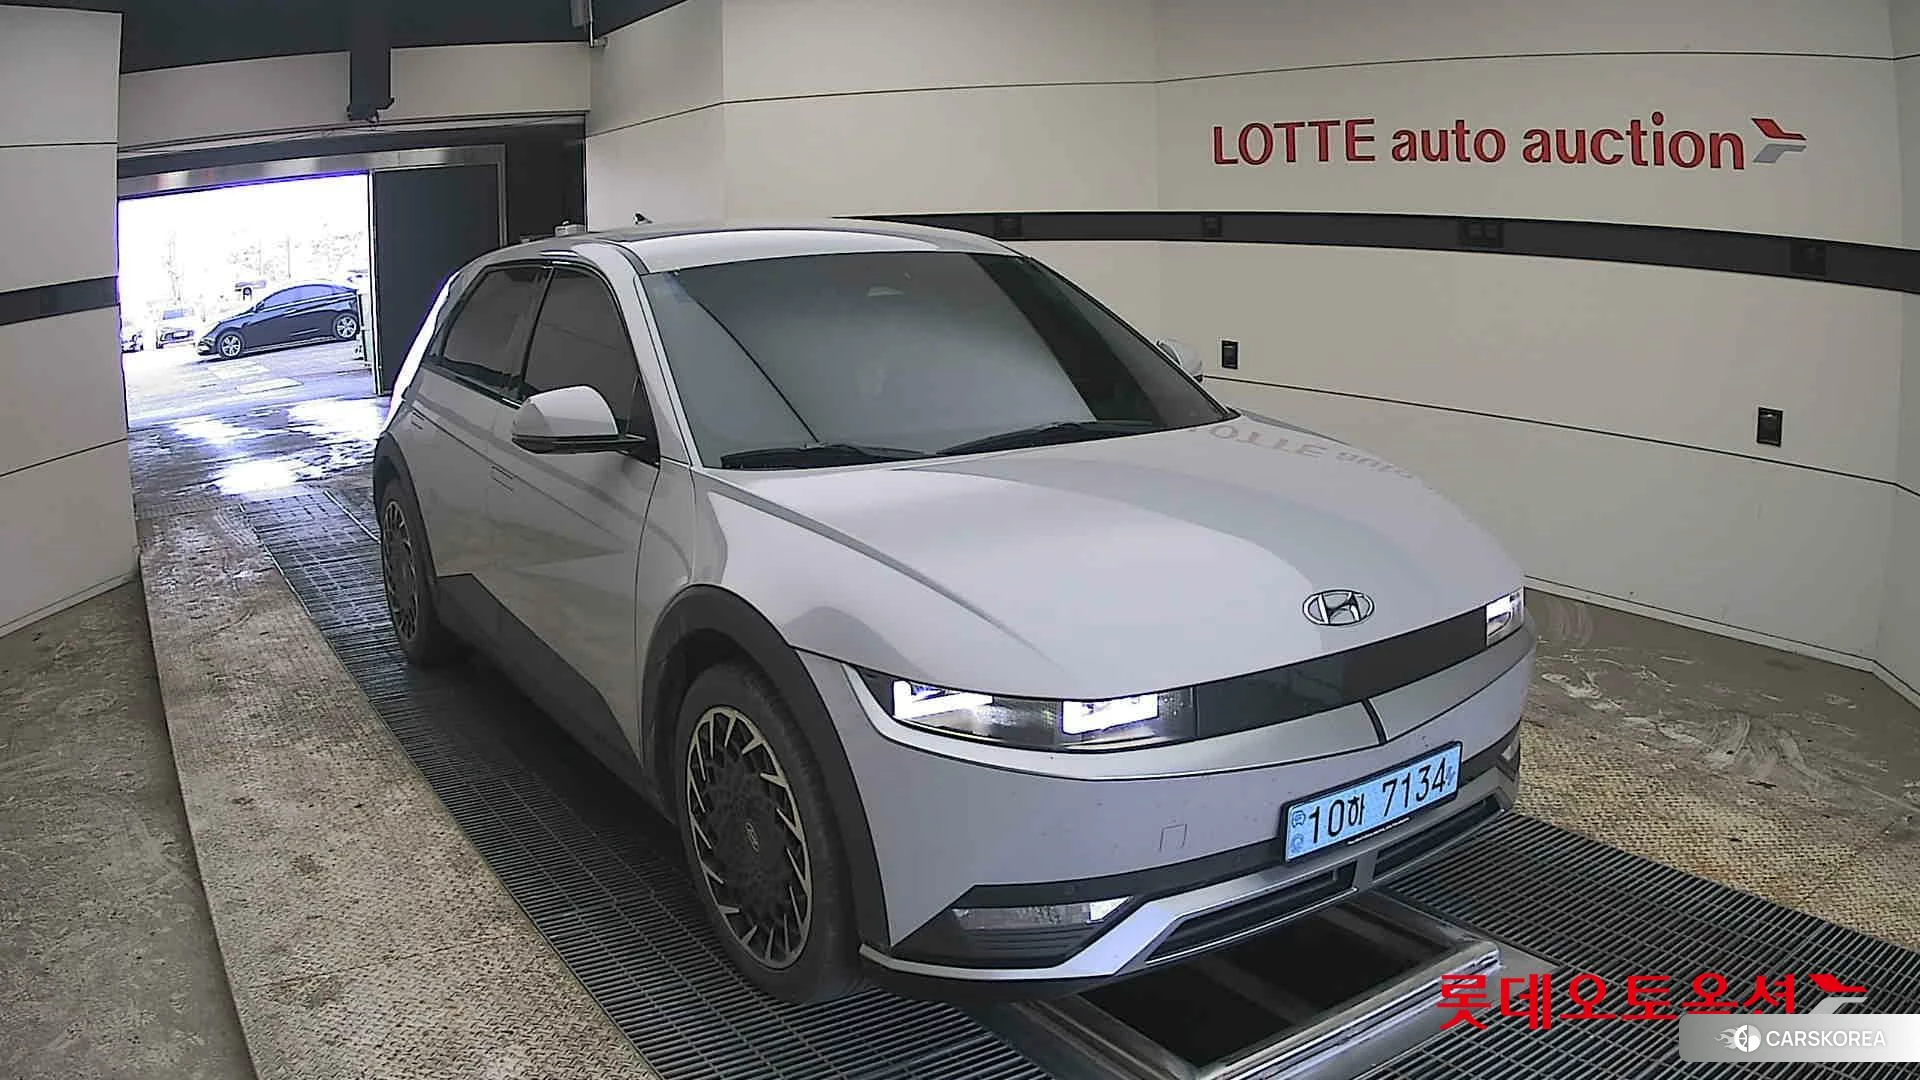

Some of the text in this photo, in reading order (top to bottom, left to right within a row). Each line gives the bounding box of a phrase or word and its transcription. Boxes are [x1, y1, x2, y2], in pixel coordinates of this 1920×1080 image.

[1213, 111, 1746, 170] LOTTE auto auction
[1309, 757, 1447, 844] 10하 7134
